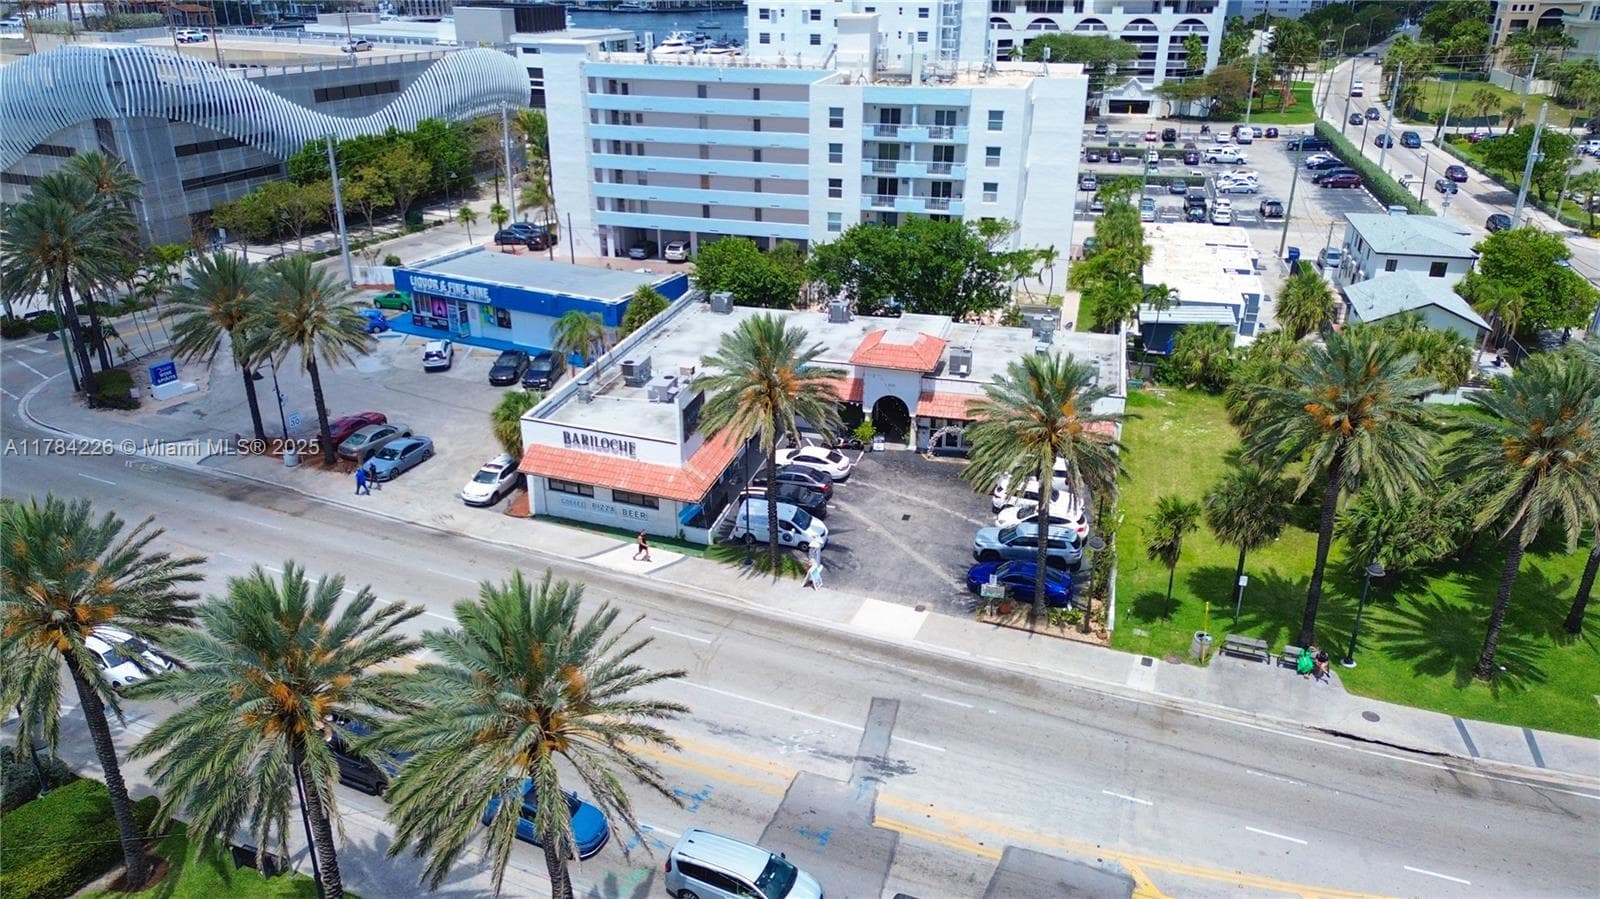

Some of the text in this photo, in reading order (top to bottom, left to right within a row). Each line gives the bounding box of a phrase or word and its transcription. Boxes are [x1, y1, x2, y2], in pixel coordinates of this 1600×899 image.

[410, 275, 489, 300] LIQUOR & FINE WINE
[563, 431, 637, 456] BARILOCHE
[622, 508, 646, 519] BEER
